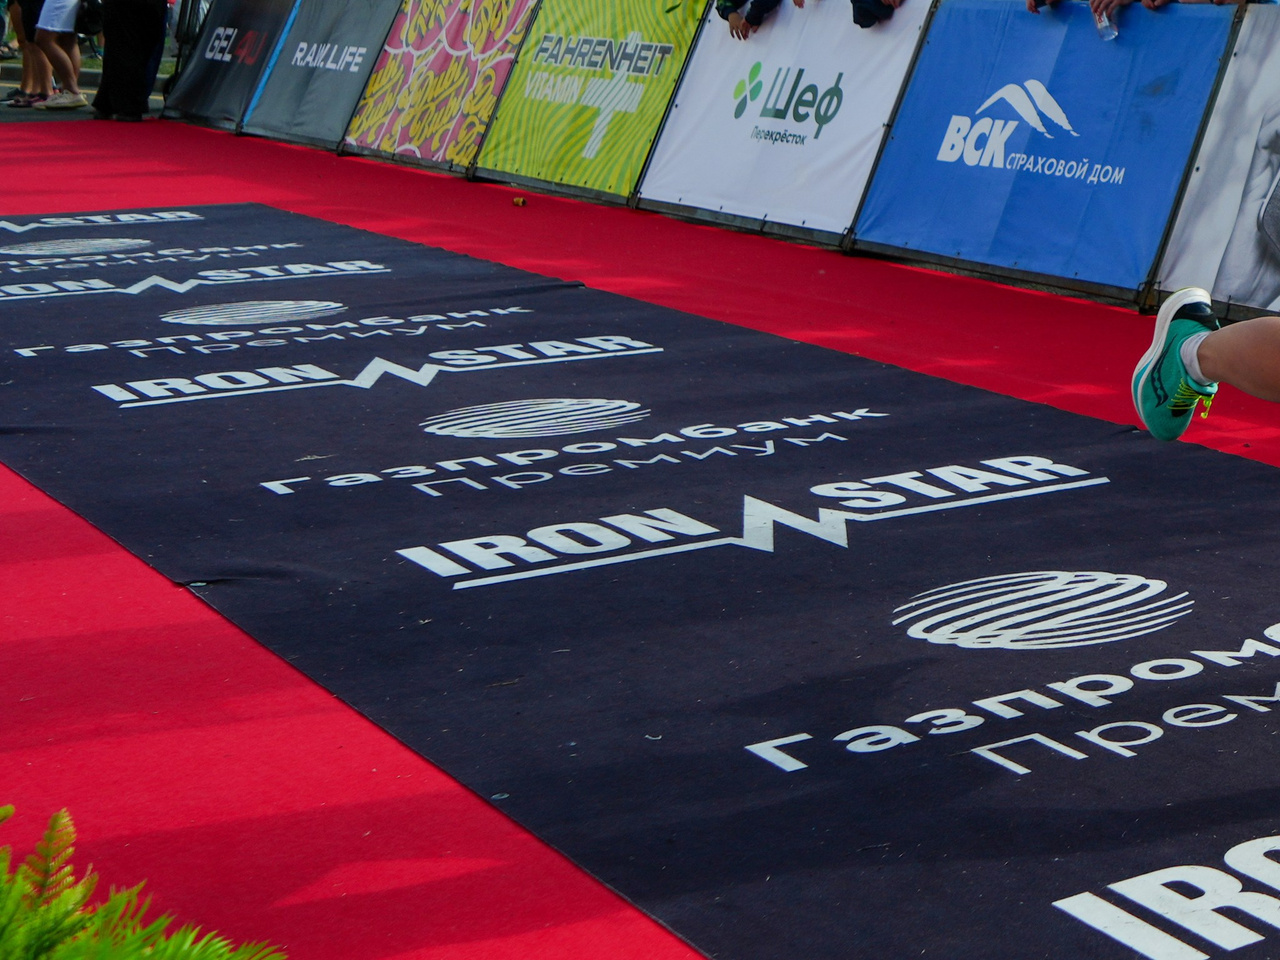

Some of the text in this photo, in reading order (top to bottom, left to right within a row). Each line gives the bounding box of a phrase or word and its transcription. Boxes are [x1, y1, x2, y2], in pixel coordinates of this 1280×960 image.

[532, 33, 674, 77] FAHRENHEIT
[524, 70, 585, 104] VITAMIN
[759, 67, 844, 139] Шеф
[751, 125, 807, 145] Перекрёсток
[936, 115, 1020, 168] ВСК
[1005, 153, 1126, 185] СТРАХОВОЙ ДОМ
[40, 211, 201, 224] STAR
[198, 260, 386, 281] STAR
[14, 305, 534, 358] Газпромбанк
[128, 320, 488, 358] Премиум
[91, 335, 655, 402] IRON STAR
[260, 407, 890, 495] Газпромбанк
[412, 431, 850, 497] Премиум
[395, 455, 1091, 578] IRON STAR
